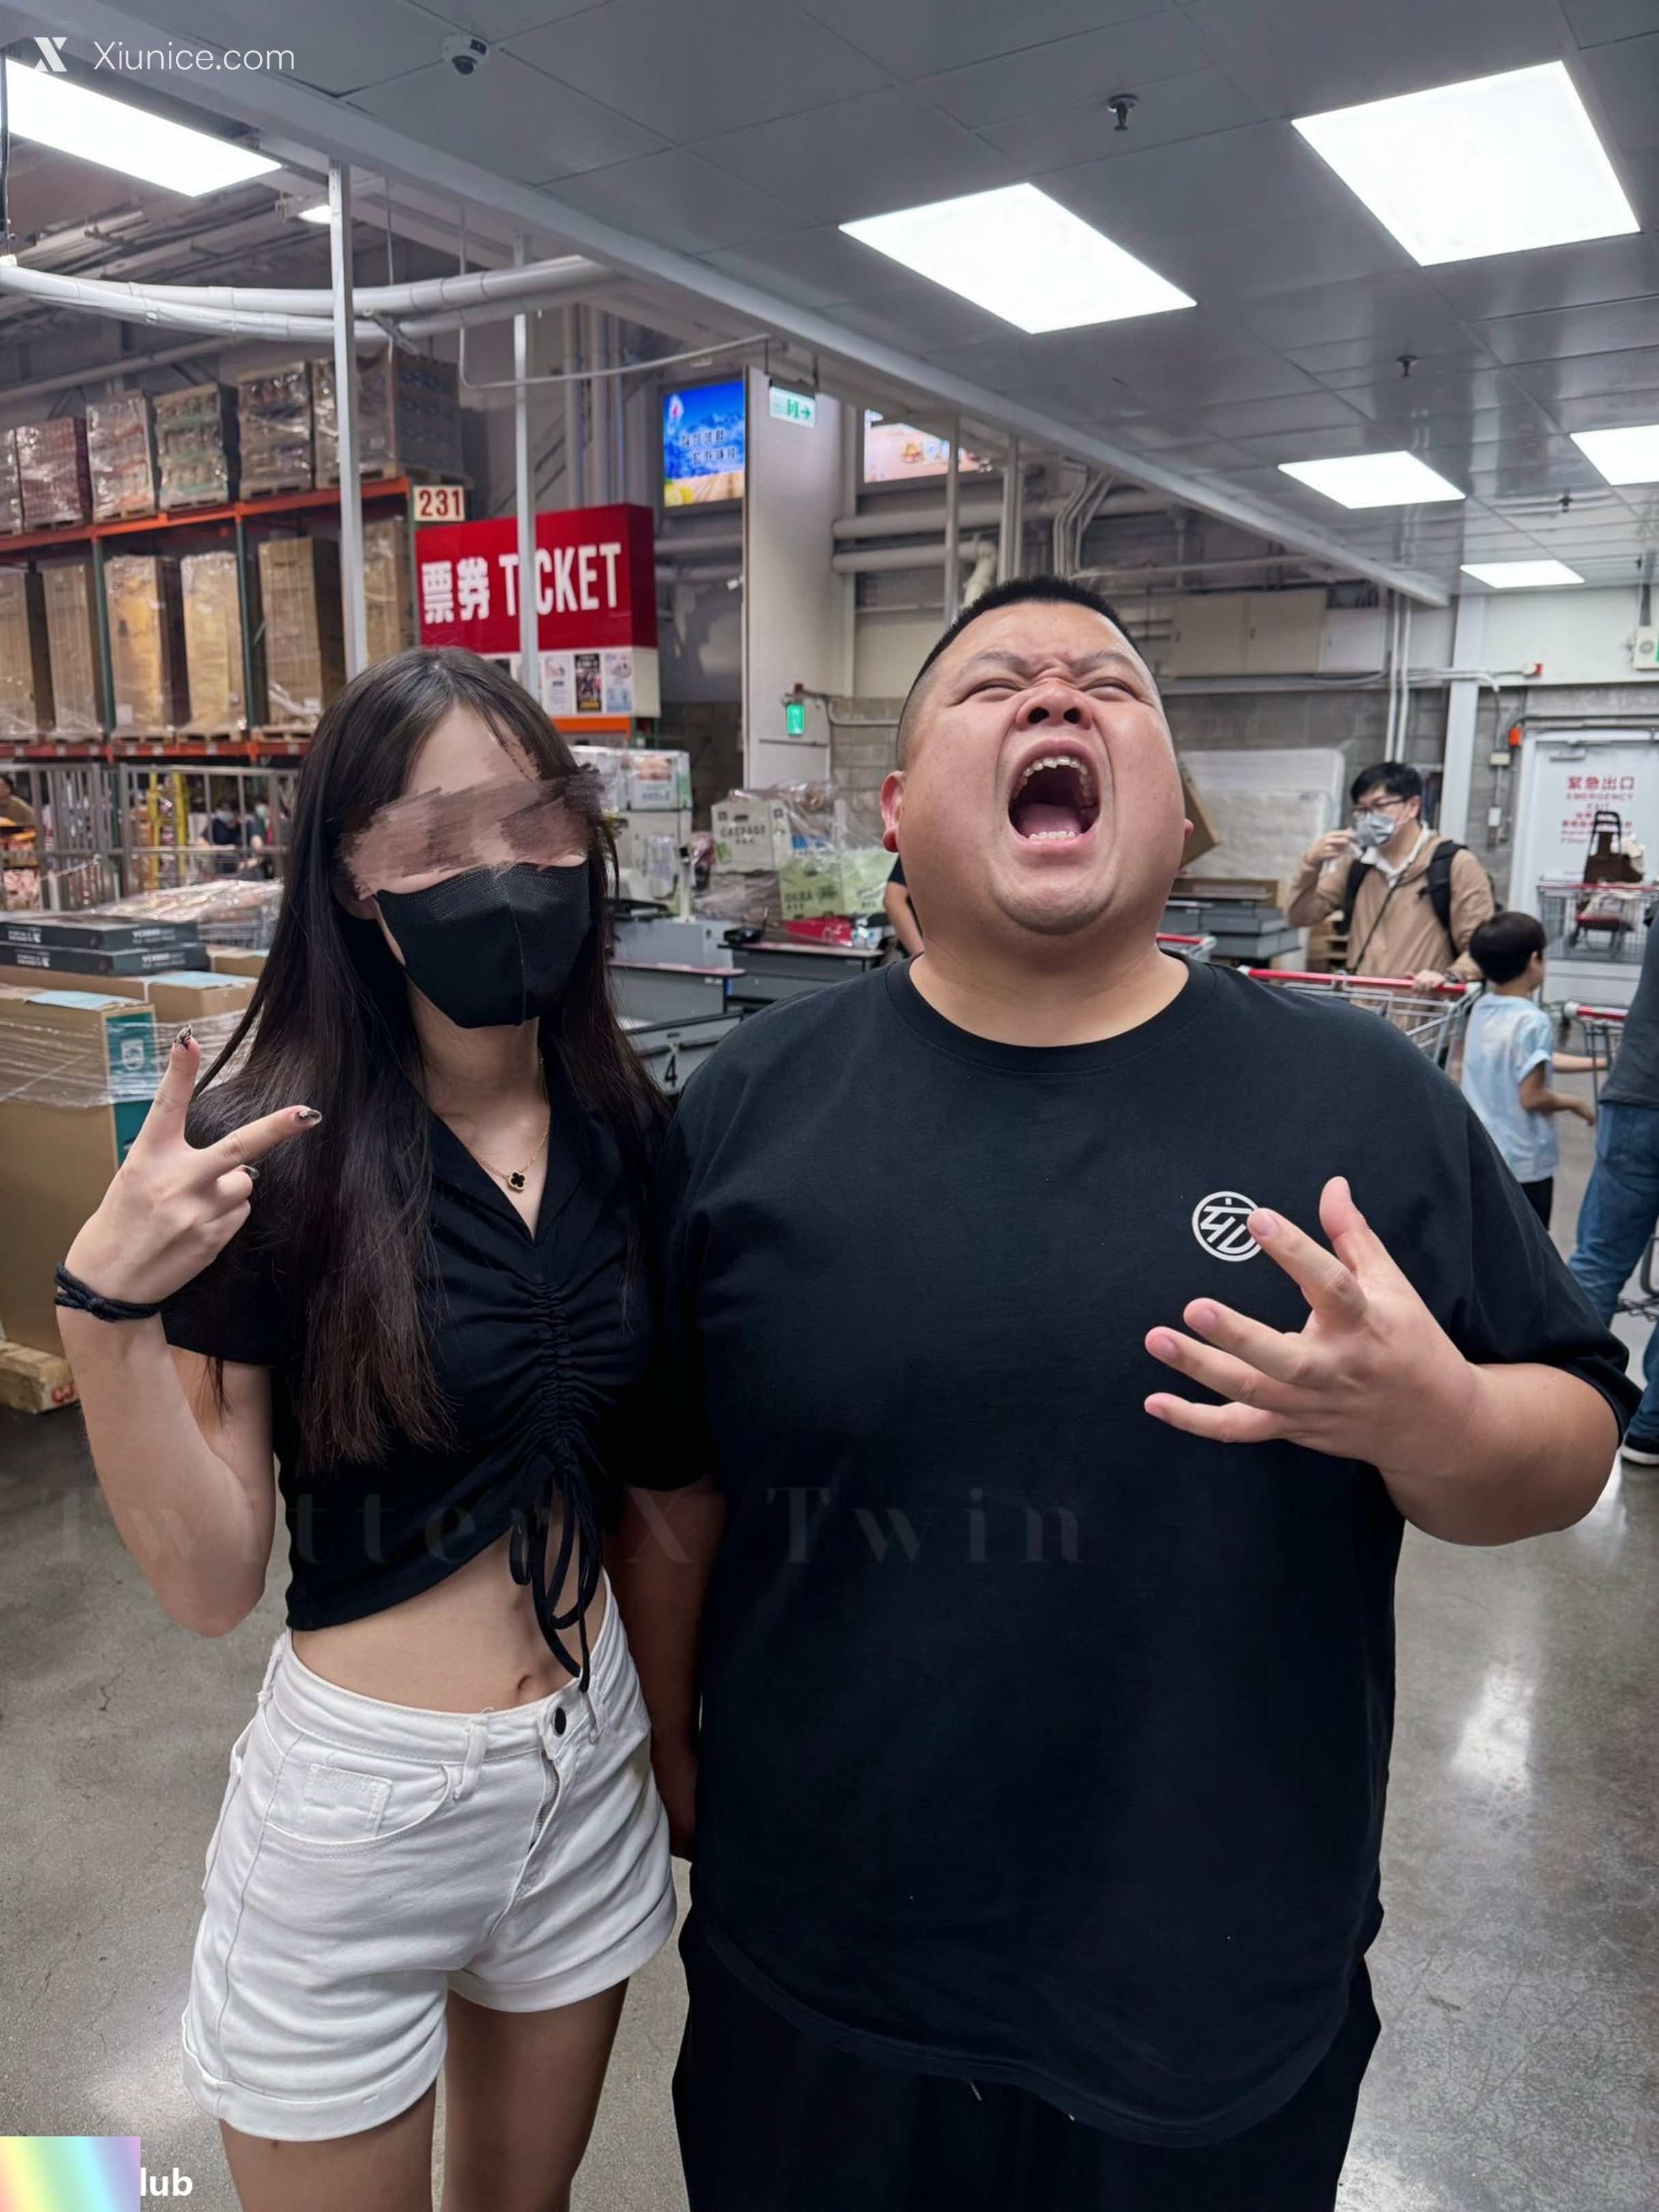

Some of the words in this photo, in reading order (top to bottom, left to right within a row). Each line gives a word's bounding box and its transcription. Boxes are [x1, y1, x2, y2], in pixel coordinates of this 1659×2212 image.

[419, 490, 462, 517] 231
[421, 556, 490, 624] 票券
[498, 542, 622, 617] TCKET
[1568, 775, 1635, 790] 緊急出口
